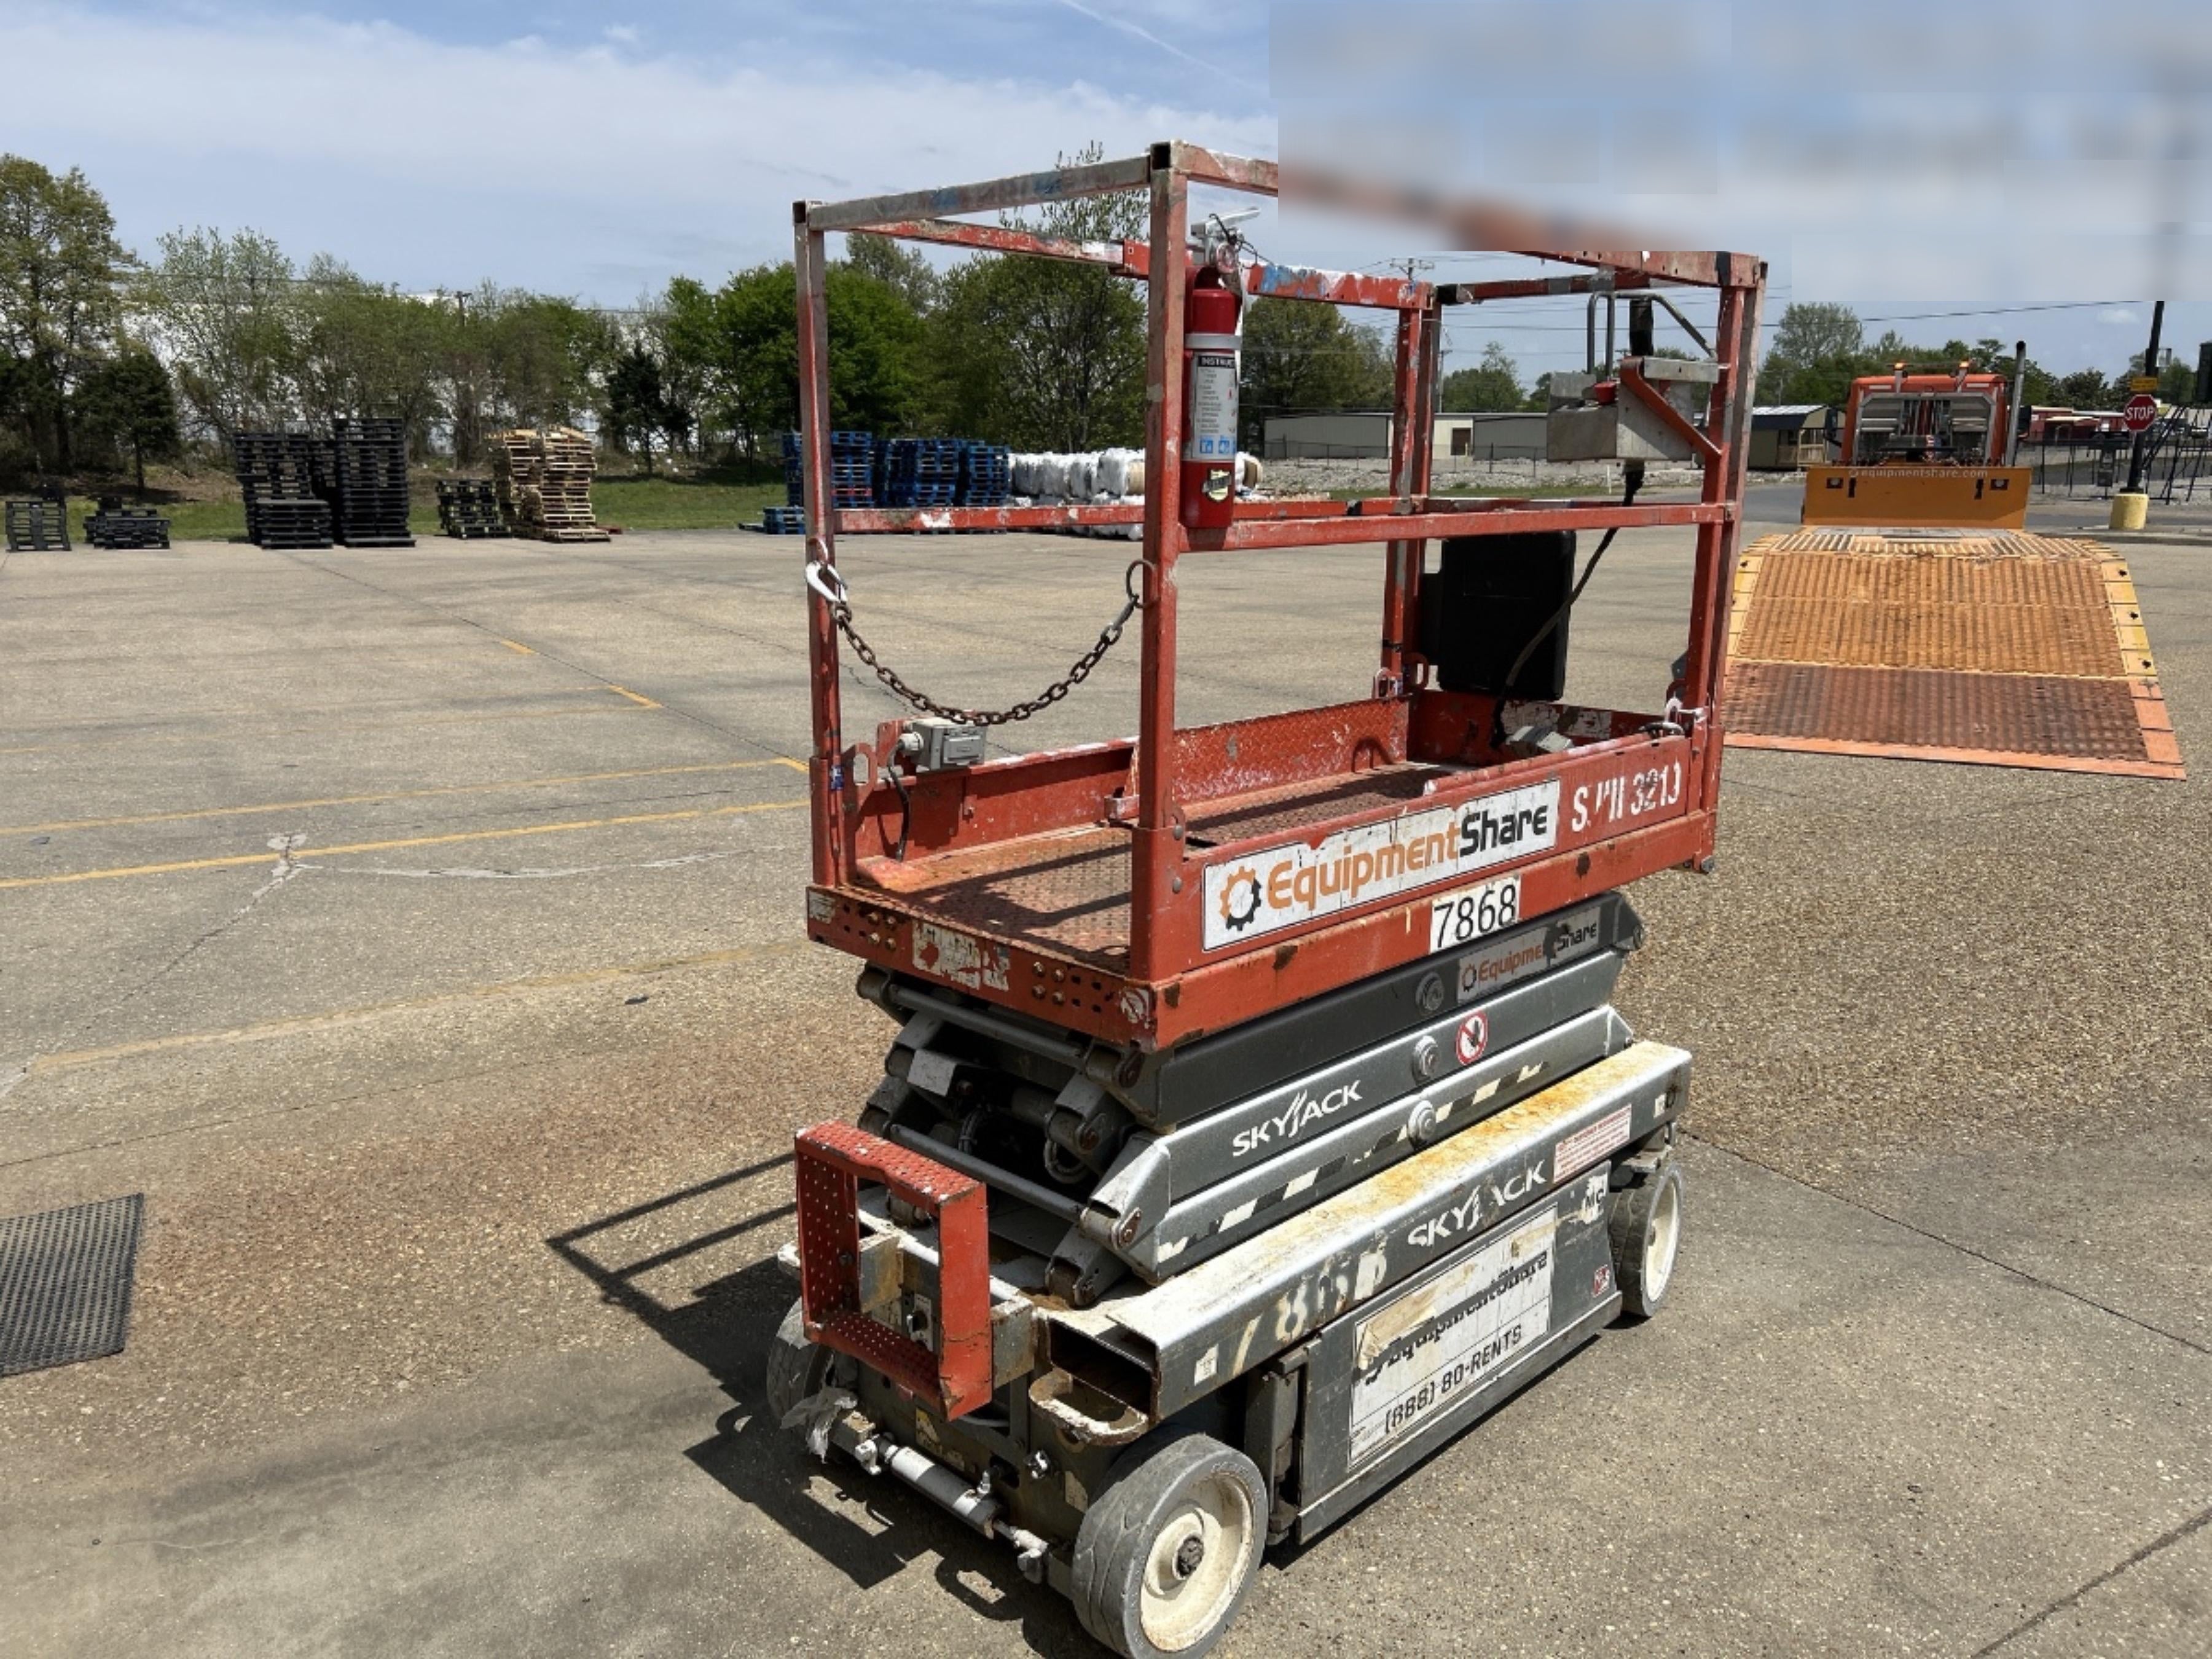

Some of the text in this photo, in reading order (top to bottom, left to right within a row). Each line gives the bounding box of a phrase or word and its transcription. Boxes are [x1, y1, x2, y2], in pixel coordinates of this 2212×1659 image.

[2126, 407, 2154, 420] STOP
[1267, 804, 1548, 911] EquipmentShare
[1434, 884, 1516, 948] 7868
[1478, 923, 1597, 981] EquipmeShare
[1233, 1080, 1363, 1156] SKYJACK
